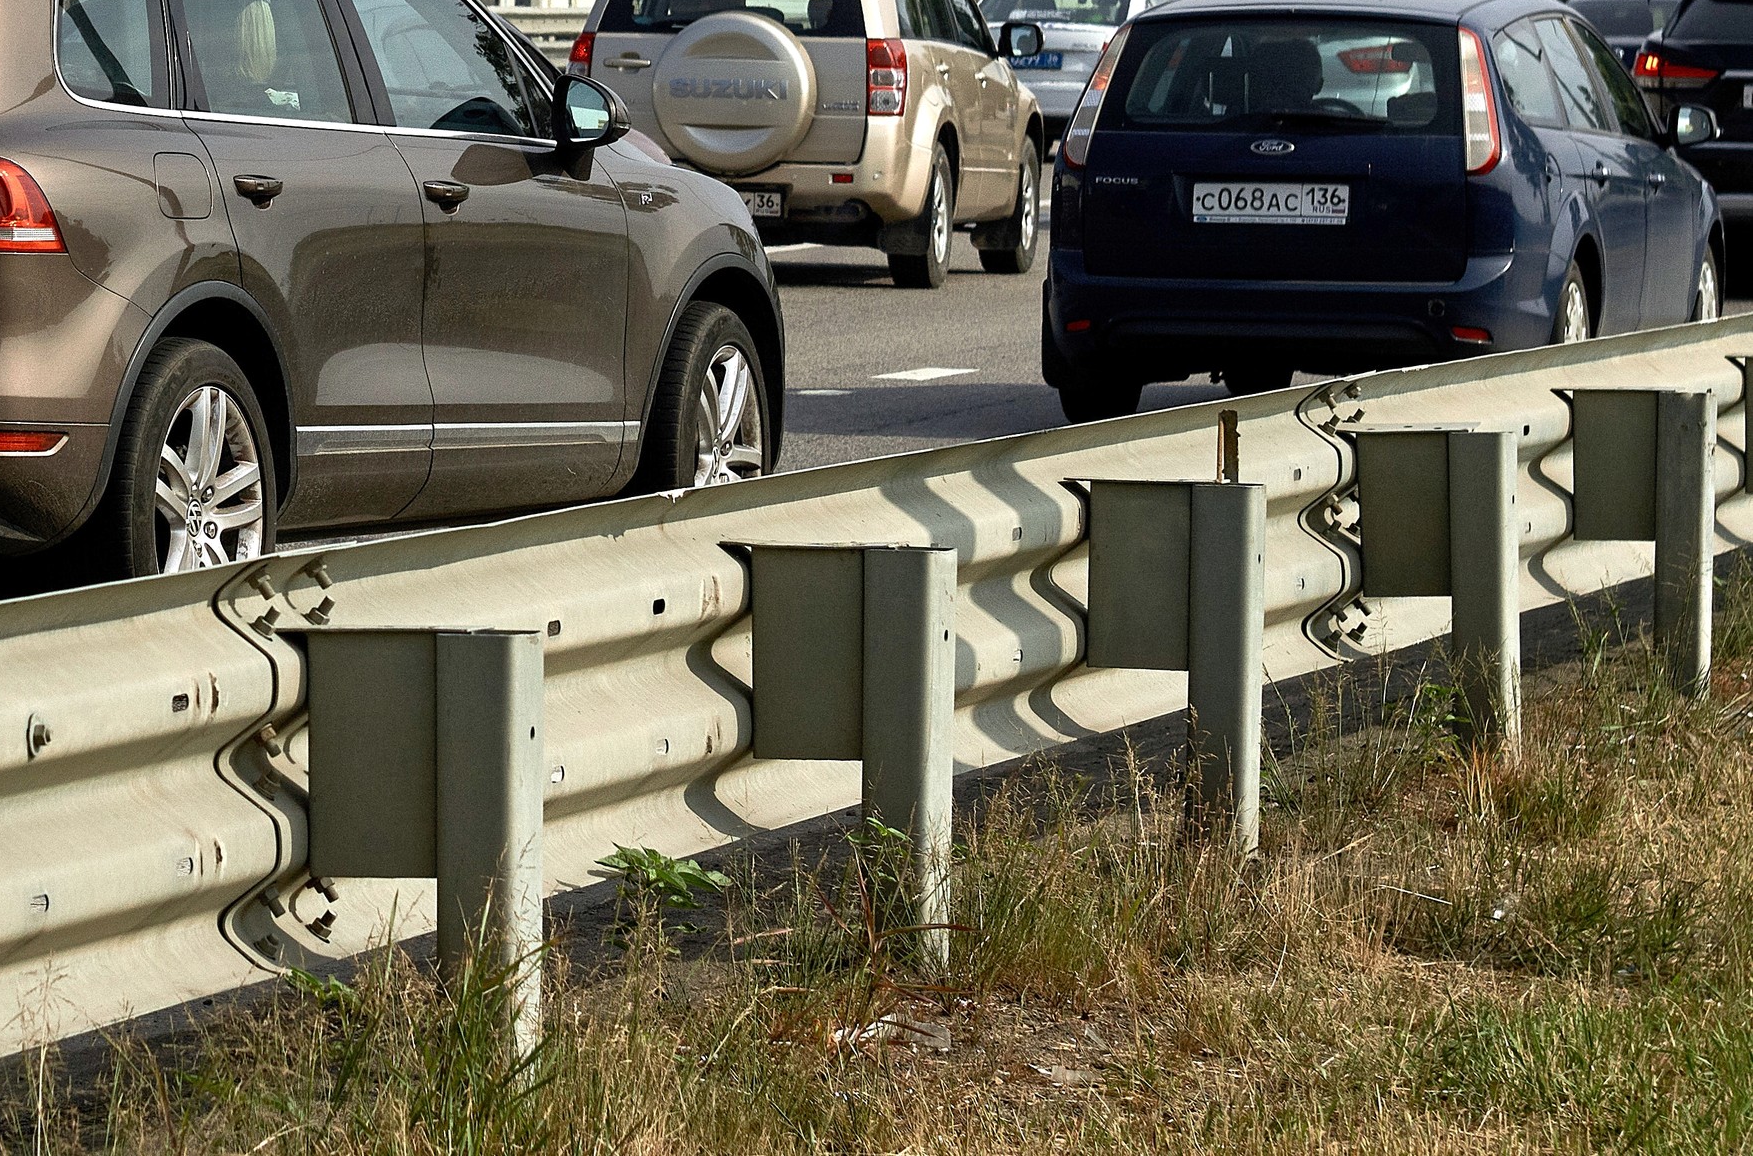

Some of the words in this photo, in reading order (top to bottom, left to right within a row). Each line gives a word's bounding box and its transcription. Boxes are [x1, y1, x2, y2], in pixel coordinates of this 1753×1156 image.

[668, 77, 789, 100] SUZUKI
[1095, 177, 1139, 185] FOCUS
[757, 194, 775, 209] 36
[1305, 187, 1341, 207] 136
[1312, 206, 1331, 214] RUS
